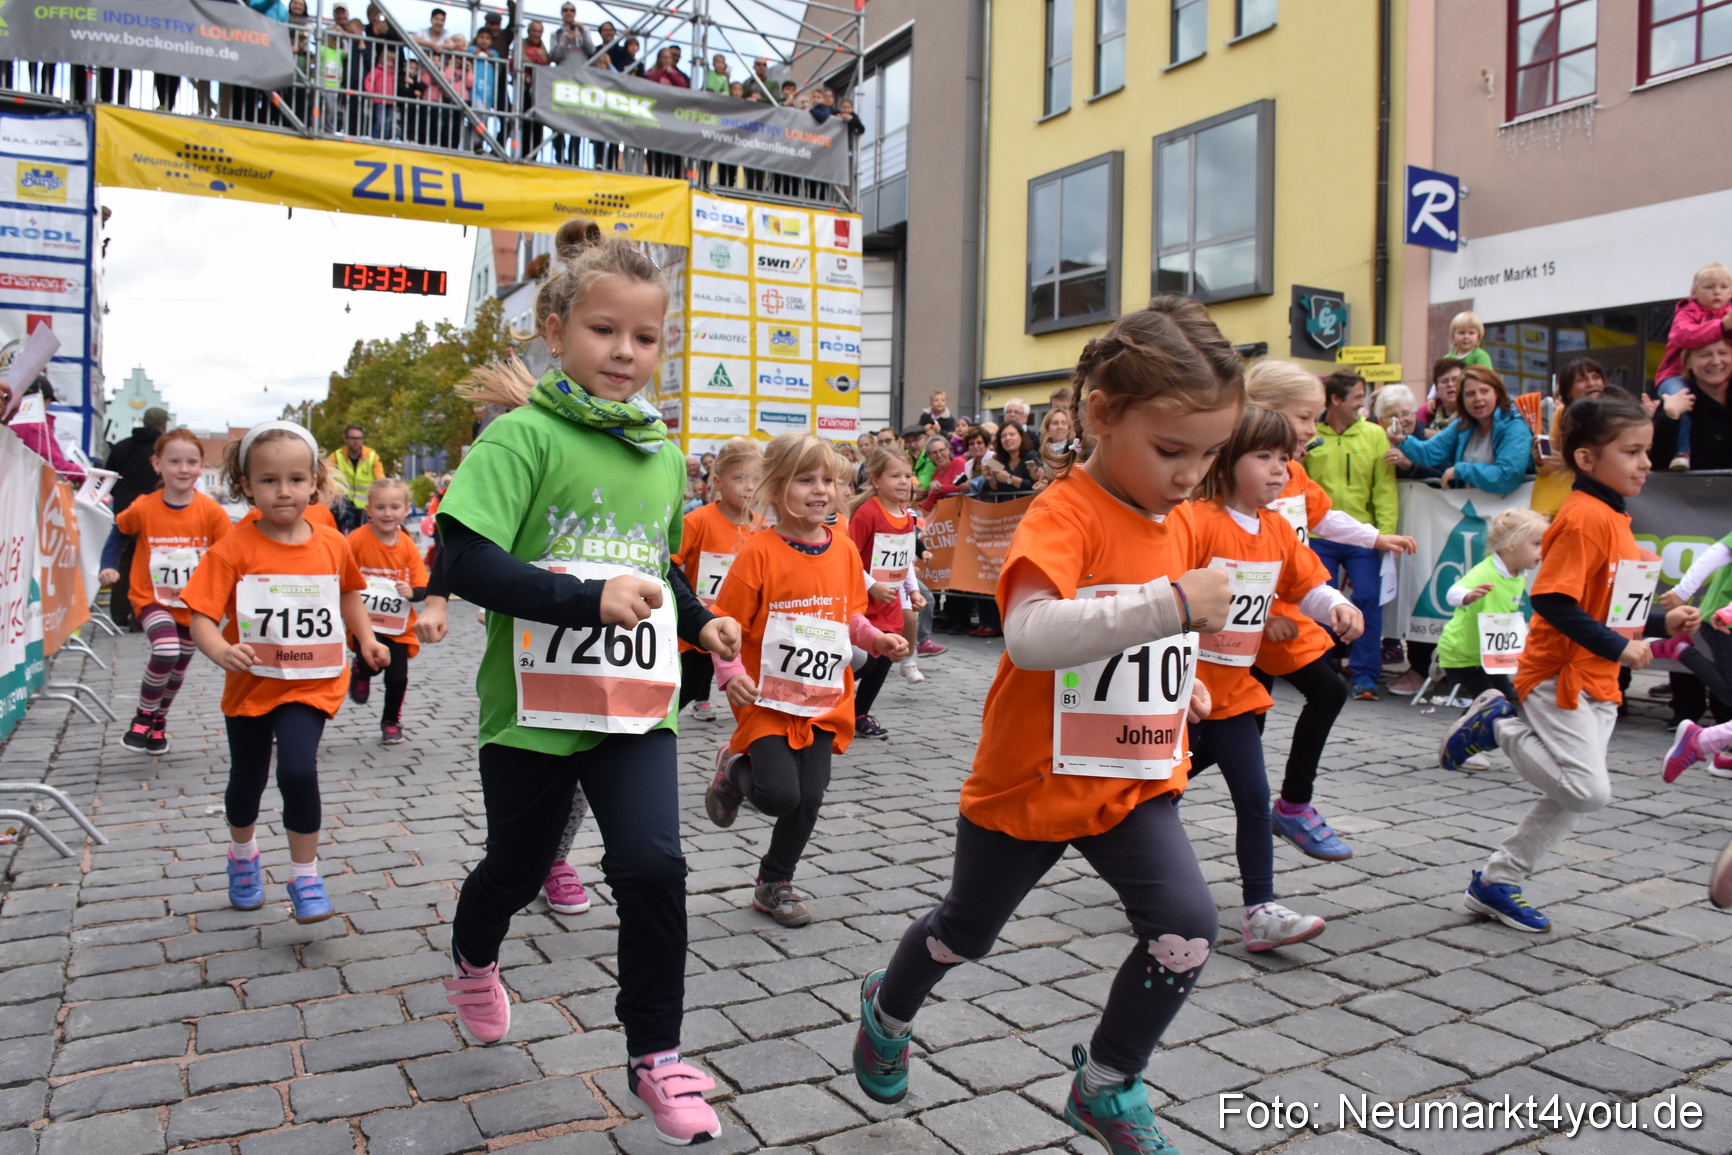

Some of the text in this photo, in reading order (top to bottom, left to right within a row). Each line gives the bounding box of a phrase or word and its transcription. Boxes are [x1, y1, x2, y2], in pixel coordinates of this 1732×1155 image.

[34, 5, 271, 48] OFFICE INDUSTRY LOUNGE
[70, 28, 240, 61] www.bockonline.de
[552, 80, 659, 121] BOCK
[674, 107, 833, 148] OFFICE INDUSTRY LOUNGE
[701, 128, 812, 160] www.bockonline.de
[132, 152, 275, 181] Neumarkter Stadtlauf
[352, 160, 485, 211] ZIEL
[552, 202, 665, 220] Neumarkter Stadtlauf
[757, 256, 791, 269] swn
[1458, 261, 1556, 290] Unterer Markt 15
[785, 296, 803, 304] CODE
[785, 303, 807, 312] CLINIC
[709, 332, 748, 344] VARIOTEC
[583, 538, 661, 567] BOCK
[881, 550, 908, 567] 7121
[160, 567, 198, 585] 711
[281, 585, 320, 595] BOCK
[361, 594, 402, 613] 7163
[769, 594, 833, 610] Neumarkter
[255, 608, 333, 638] 7153
[1410, 622, 1427, 634] Jura
[805, 626, 836, 639] BOCK
[545, 622, 657, 670] 7260
[276, 650, 313, 661] Helena
[779, 644, 842, 681] 7287
[1063, 694, 1076, 704] B1
